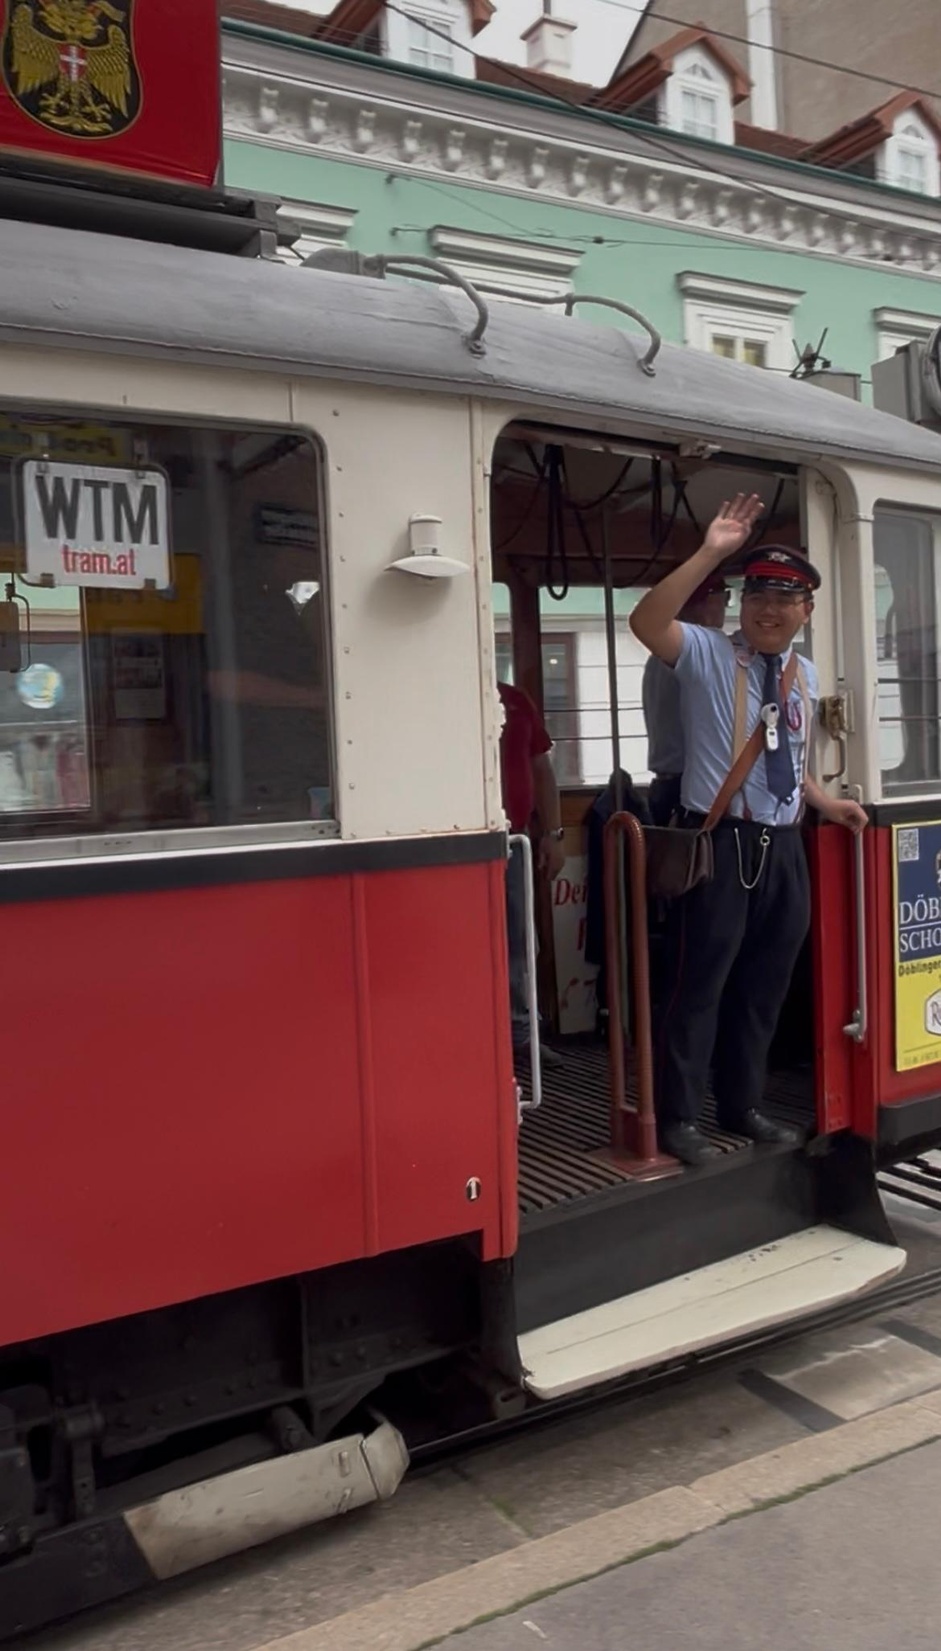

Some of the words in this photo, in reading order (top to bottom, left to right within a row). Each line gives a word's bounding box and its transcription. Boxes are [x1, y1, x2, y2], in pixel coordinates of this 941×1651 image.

[35, 475, 159, 545] WTM
[61, 544, 136, 576] tram.at
[899, 893, 941, 924] DÖB
